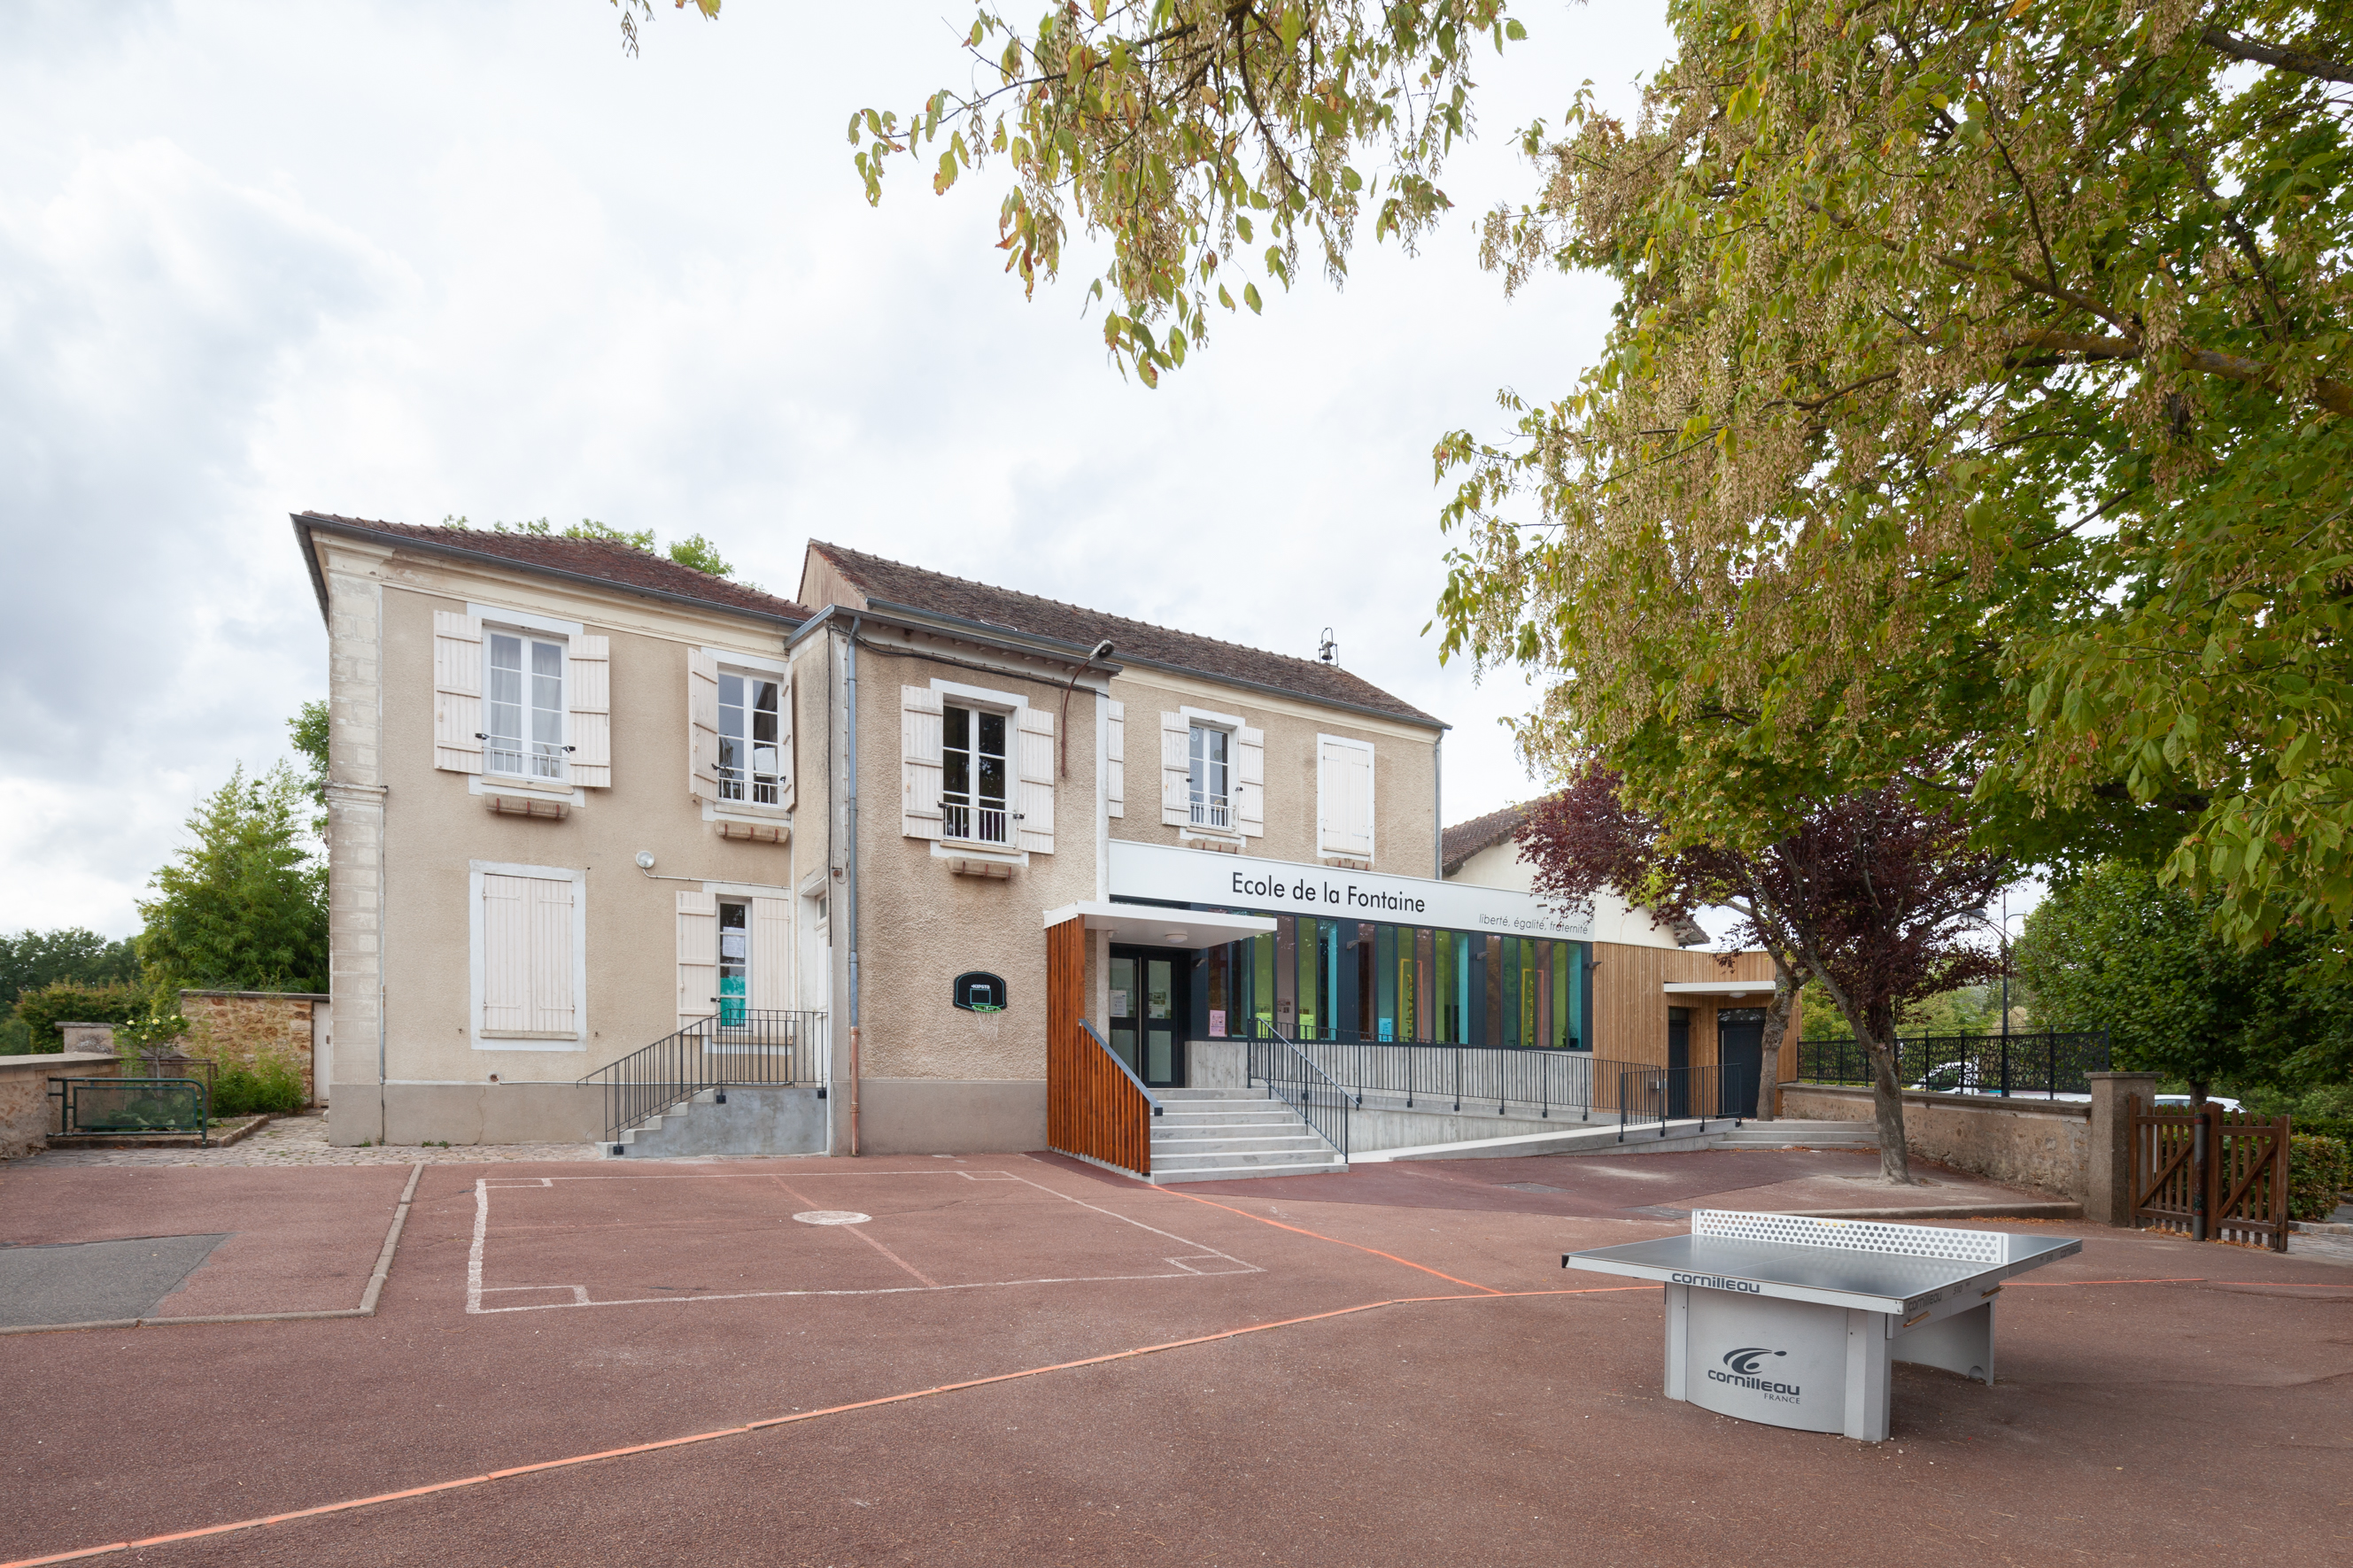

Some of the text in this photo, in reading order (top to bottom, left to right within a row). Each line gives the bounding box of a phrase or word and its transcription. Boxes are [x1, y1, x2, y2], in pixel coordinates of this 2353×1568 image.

[1232, 871, 1426, 913] Ecole de la Fontaine
[1479, 913, 1511, 928] liberté,
[1513, 917, 1547, 931] égalité,
[1671, 1272, 1761, 1294] cornilleau
[1707, 1369, 1800, 1396] cornilleau
[1763, 1393, 1800, 1405] FRANCE
